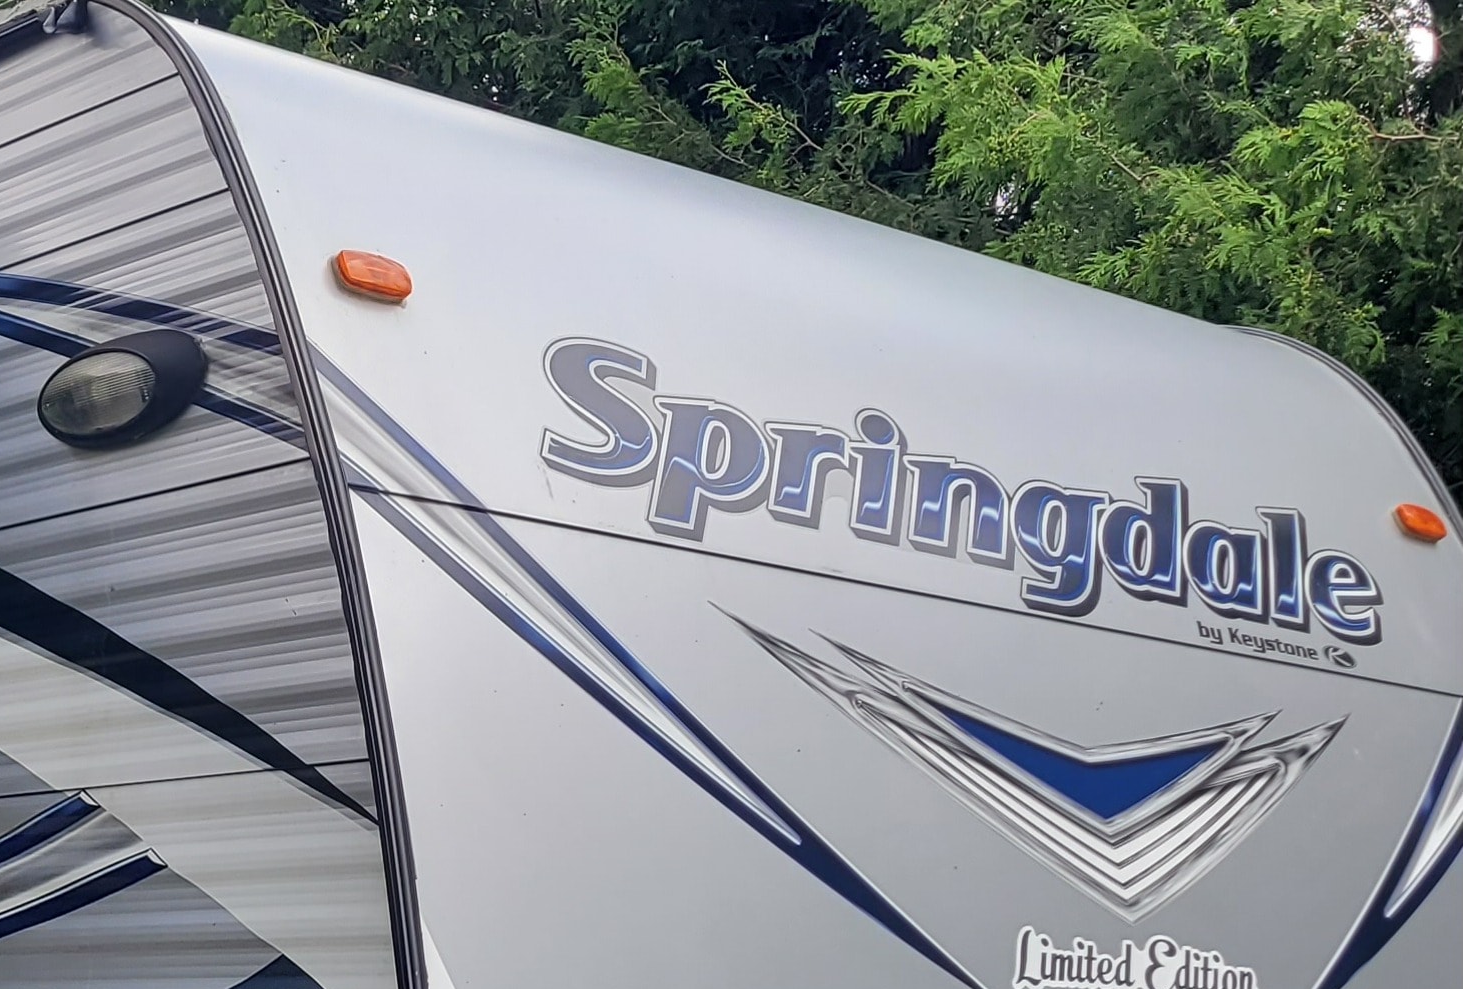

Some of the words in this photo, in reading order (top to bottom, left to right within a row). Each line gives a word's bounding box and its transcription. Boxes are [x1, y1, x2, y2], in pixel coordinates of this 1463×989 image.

[541, 336, 1382, 644] Springdale
[1196, 621, 1223, 645] by
[1227, 627, 1319, 660] Keystone
[1016, 929, 1134, 988] Limited
